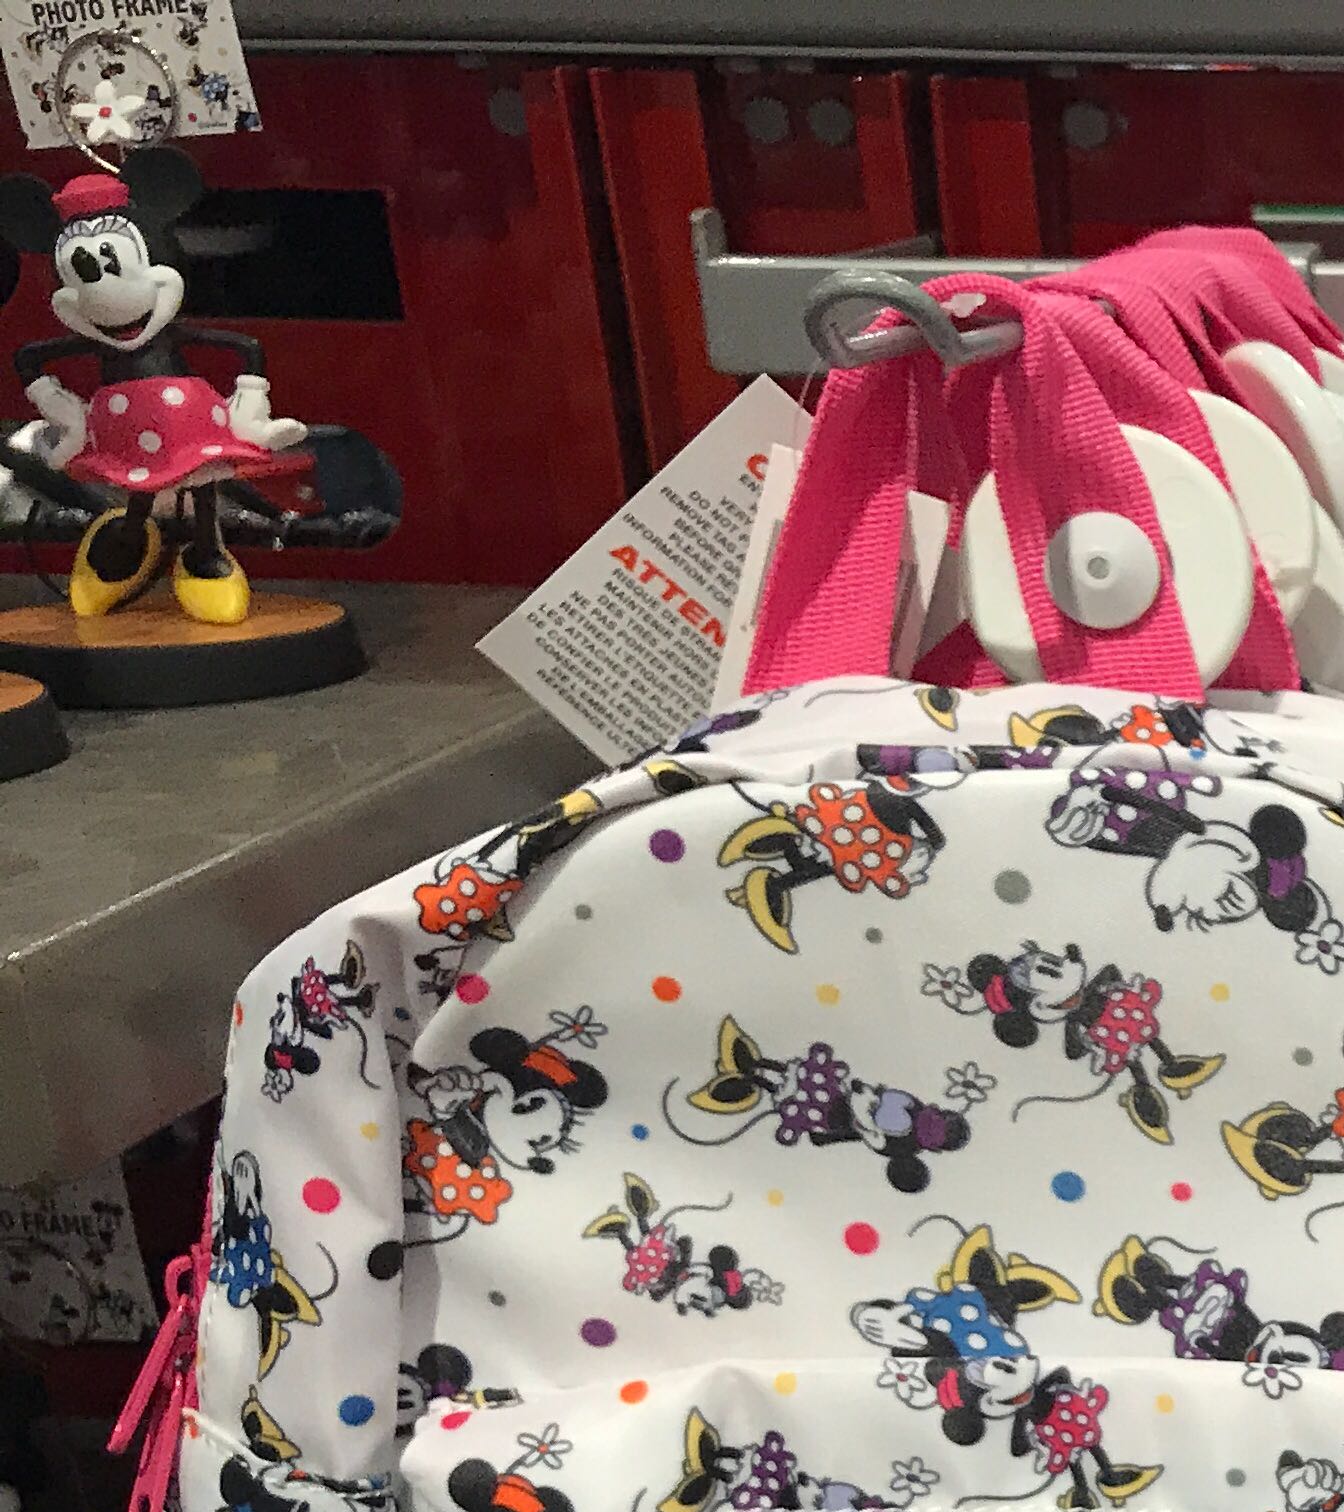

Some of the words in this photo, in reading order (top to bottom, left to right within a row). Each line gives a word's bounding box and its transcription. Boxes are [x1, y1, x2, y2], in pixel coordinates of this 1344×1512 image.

[32, 0, 104, 26] PHOTO
[112, 0, 189, 19] FRAME
[659, 484, 713, 533] REMOVE
[713, 530, 737, 553] TAG
[673, 517, 723, 561] BEFORE
[688, 489, 711, 511] DO
[710, 508, 739, 534] NOT
[622, 511, 708, 586] INFORMATION
[705, 582, 734, 608] FOR
[668, 531, 717, 574] PLEASE
[558, 599, 615, 649] RETIRER
[569, 588, 591, 609] NE
[589, 605, 617, 631] PAS
[615, 627, 669, 674] PORTER
[603, 579, 673, 641] MAINTENIR
[673, 637, 710, 671] HORS
[608, 544, 727, 648] ATTEN
[612, 566, 661, 610] RISQUE
[660, 607, 680, 626] DE
[526, 610, 546, 630] DE
[546, 626, 604, 678] CONFIER
[603, 674, 621, 691] LE
[534, 634, 609, 700] CONSERVER
[608, 696, 633, 719] LES
[538, 601, 566, 627] LES
[564, 622, 629, 680] ATTACHES
[629, 676, 649, 695] EN
[551, 665, 571, 684] DE
[597, 592, 626, 619] DES
[659, 644, 709, 688] JEUNES
